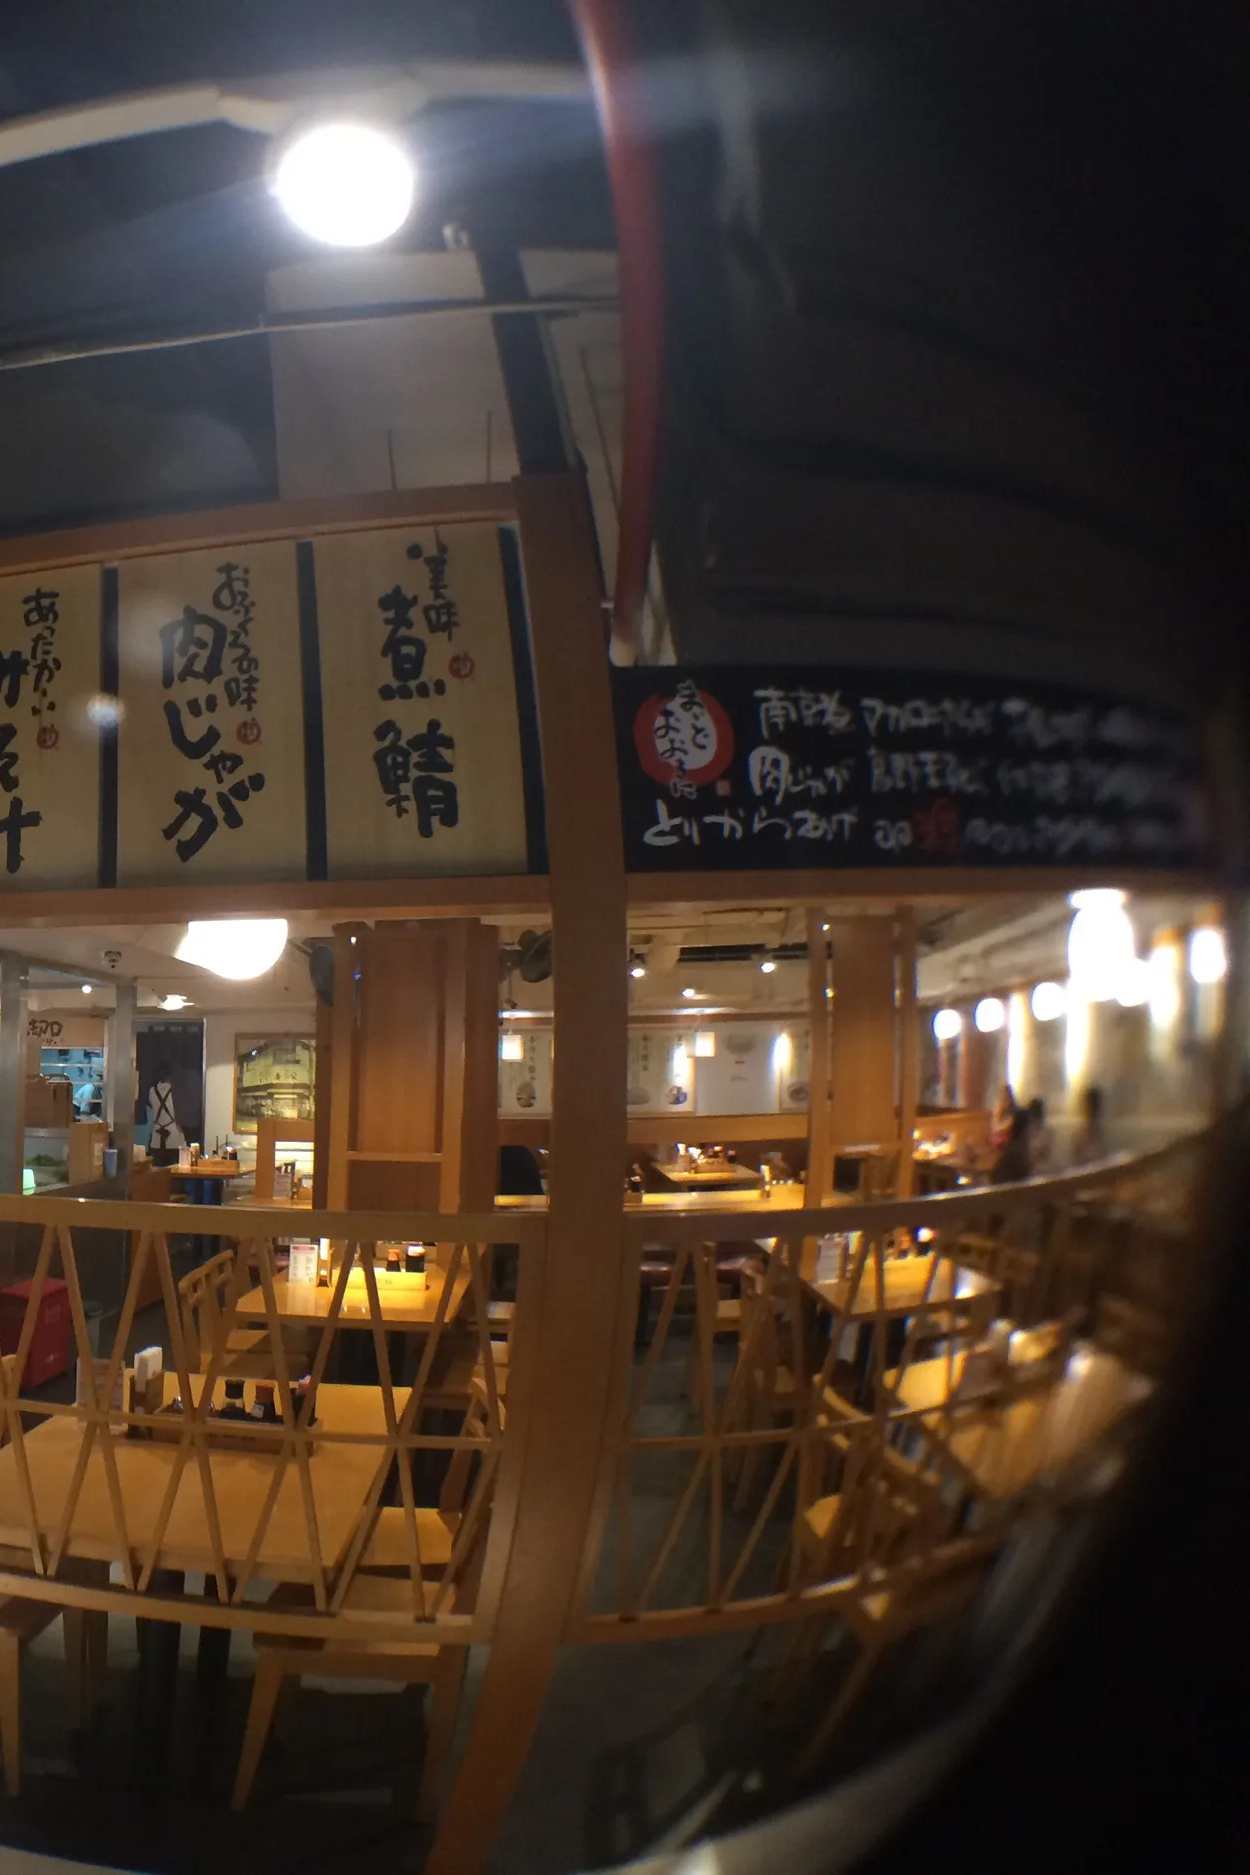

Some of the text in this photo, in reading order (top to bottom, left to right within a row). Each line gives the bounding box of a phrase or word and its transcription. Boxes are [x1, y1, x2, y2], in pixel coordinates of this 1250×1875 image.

[159, 604, 265, 863] 肉じゃが
[372, 585, 460, 840] 煮鯖
